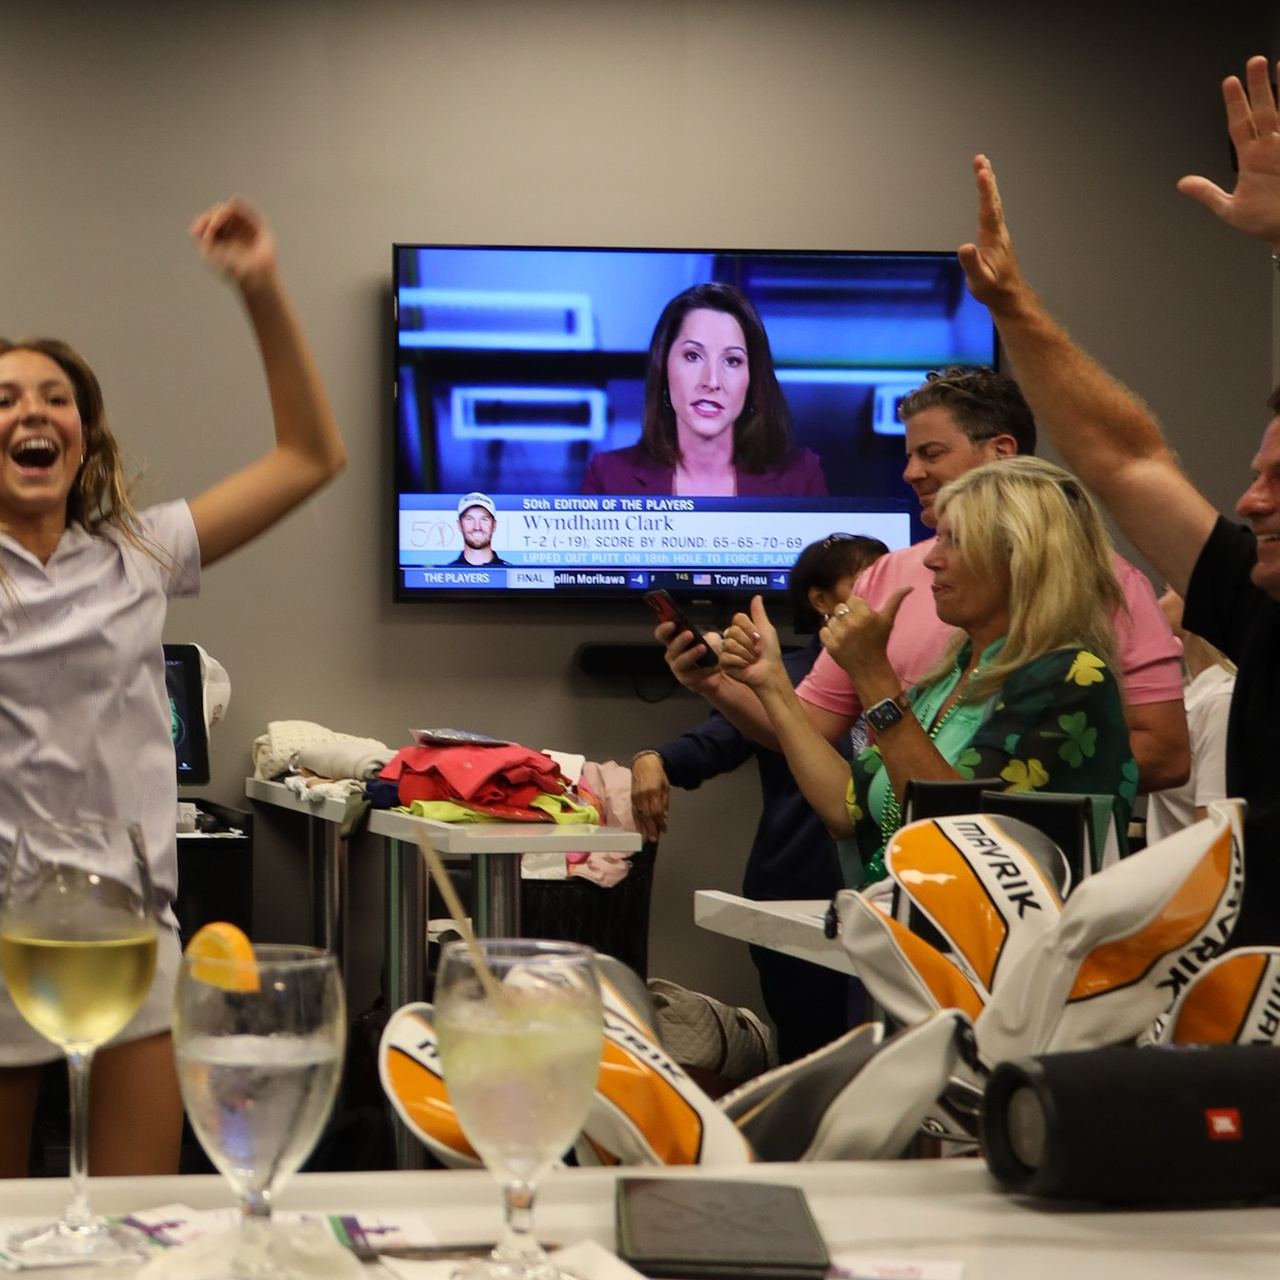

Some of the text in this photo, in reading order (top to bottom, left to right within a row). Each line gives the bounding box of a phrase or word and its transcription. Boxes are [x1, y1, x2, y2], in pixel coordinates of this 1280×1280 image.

[522, 498, 695, 511] 50th EDITION OF THE PLAYERS
[522, 514, 675, 534] Wyndham Clark
[522, 535, 548, 548] T-2
[595, 535, 635, 548] SCORE
[640, 536, 656, 548] BY
[661, 536, 708, 549] ROUND:
[713, 536, 803, 549] 65-65-70-69
[522, 552, 561, 564] LIPPED
[565, 553, 587, 564] OUT
[591, 553, 620, 564] PUTT
[623, 553, 641, 564] ON
[644, 553, 670, 565] 18th
[673, 553, 702, 565] HOLE
[706, 554, 721, 565] TO
[725, 554, 759, 565] FORCE
[423, 573, 444, 584] THE
[445, 572, 490, 584] PLAYERS
[516, 574, 544, 583] FINAL
[577, 573, 626, 585] Morikawa
[630, 574, 644, 585] -4
[713, 574, 739, 587] Tony
[740, 574, 768, 585] Finau
[773, 574, 786, 585] -4
[952, 822, 1042, 920] MAVRIK
